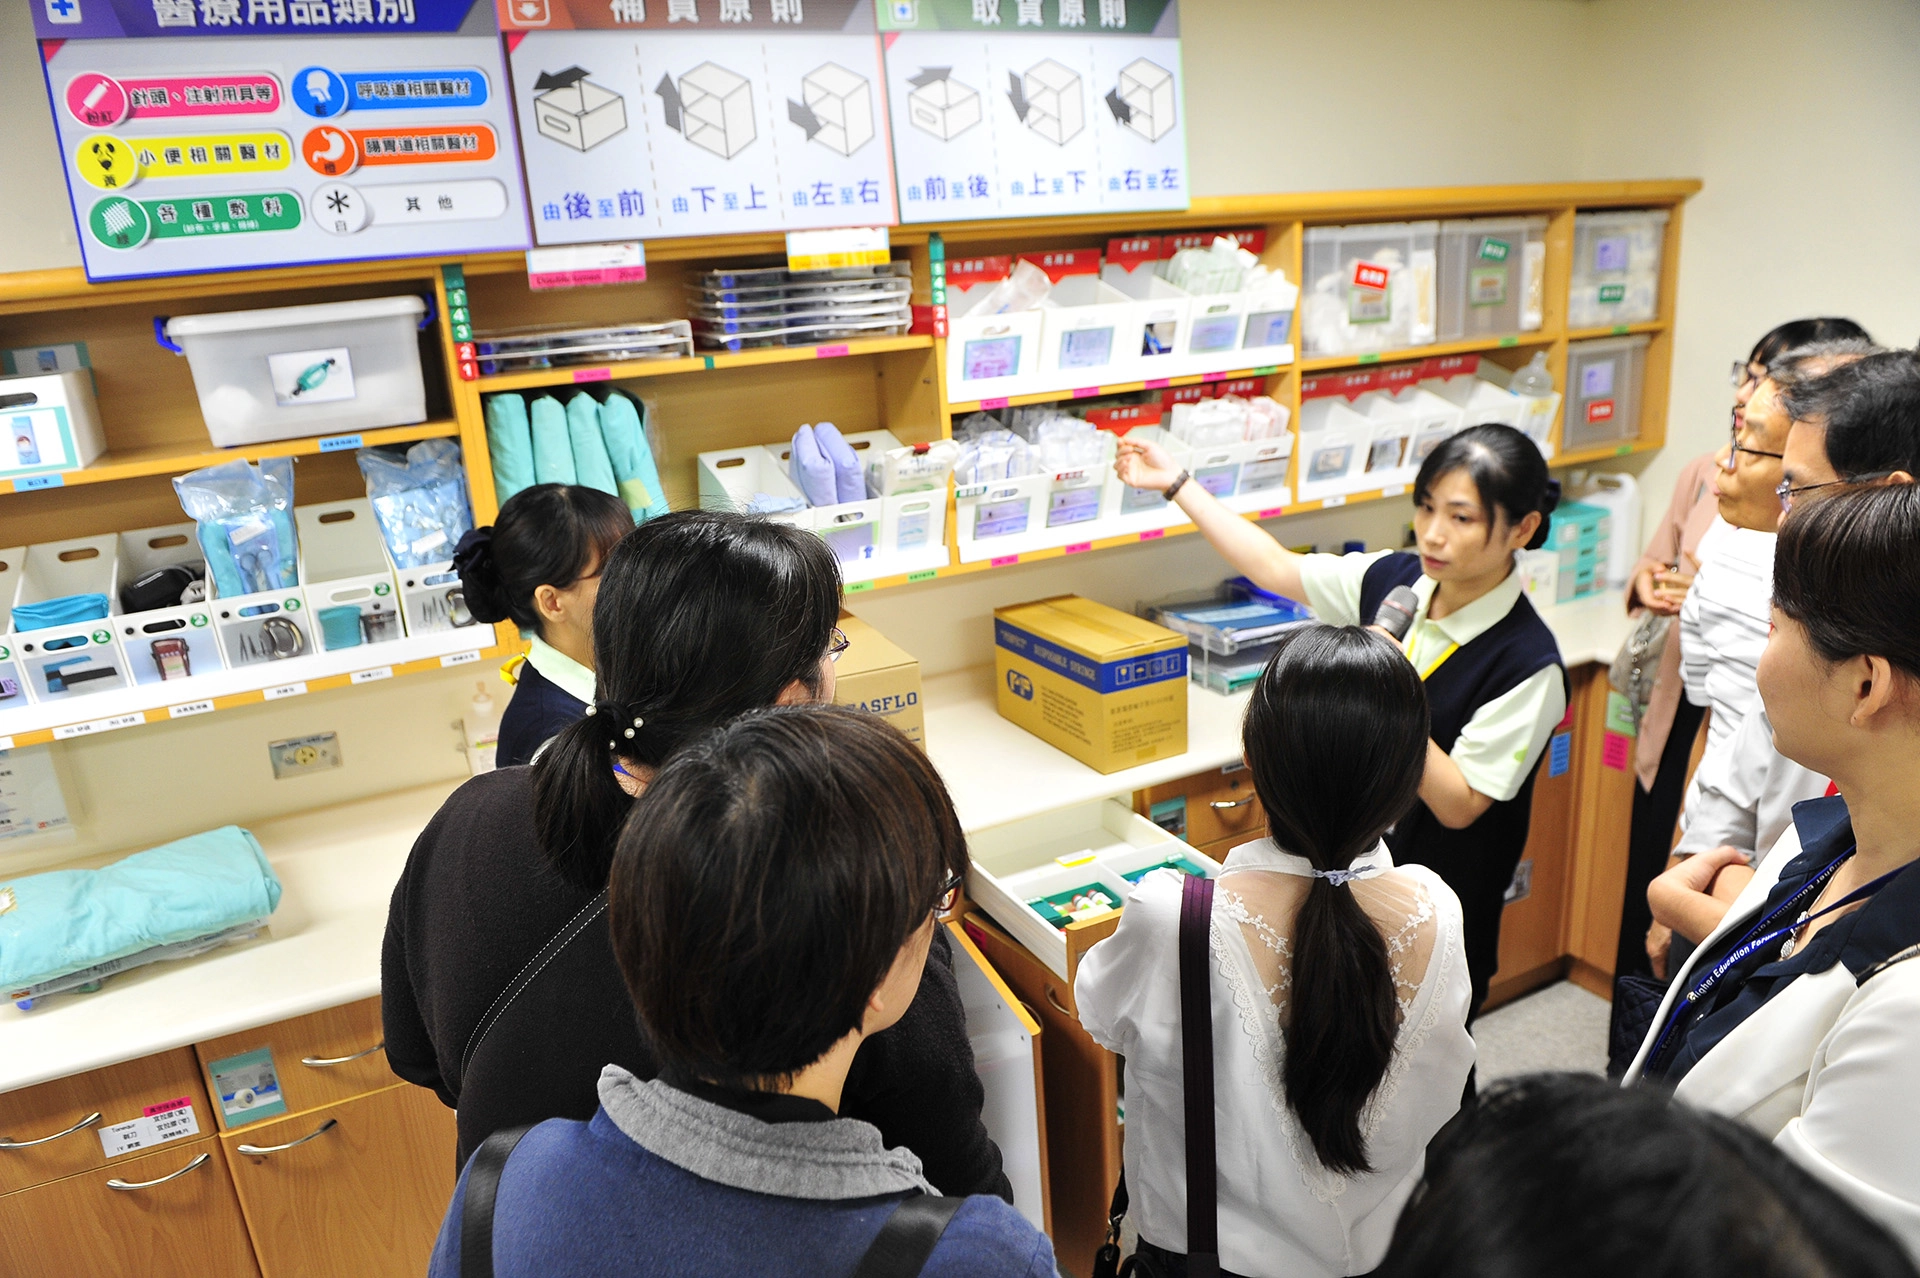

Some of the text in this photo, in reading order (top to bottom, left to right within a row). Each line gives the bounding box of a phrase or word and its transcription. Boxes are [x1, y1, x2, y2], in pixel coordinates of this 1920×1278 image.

[131, 86, 272, 108] 針頭、注射用具等
[356, 79, 472, 99] 呼吸道相關醫材
[139, 142, 281, 167] 小便相關醫材
[364, 135, 478, 157] 腸胃道相關醫材
[907, 173, 990, 201] 由前至後
[1011, 170, 1087, 197] 由上至下
[1108, 167, 1180, 192] 由右至左
[672, 184, 768, 214] 由下至上
[792, 178, 881, 207] 由左至右
[157, 197, 282, 224] 各種敷料
[406, 194, 453, 212] 其他
[543, 189, 645, 221] 由後至前
[334, 219, 348, 233] 白
[933, 276, 943, 289] 4
[453, 307, 465, 322] 4
[456, 324, 468, 339] 3
[460, 345, 472, 360] 2
[462, 362, 472, 377] 1
[376, 583, 387, 595] 2
[287, 599, 299, 611] 2
[192, 613, 206, 627] 2
[95, 630, 109, 644] 2
[1712, 946, 1750, 978] Education
[1751, 931, 1778, 950] Forum
